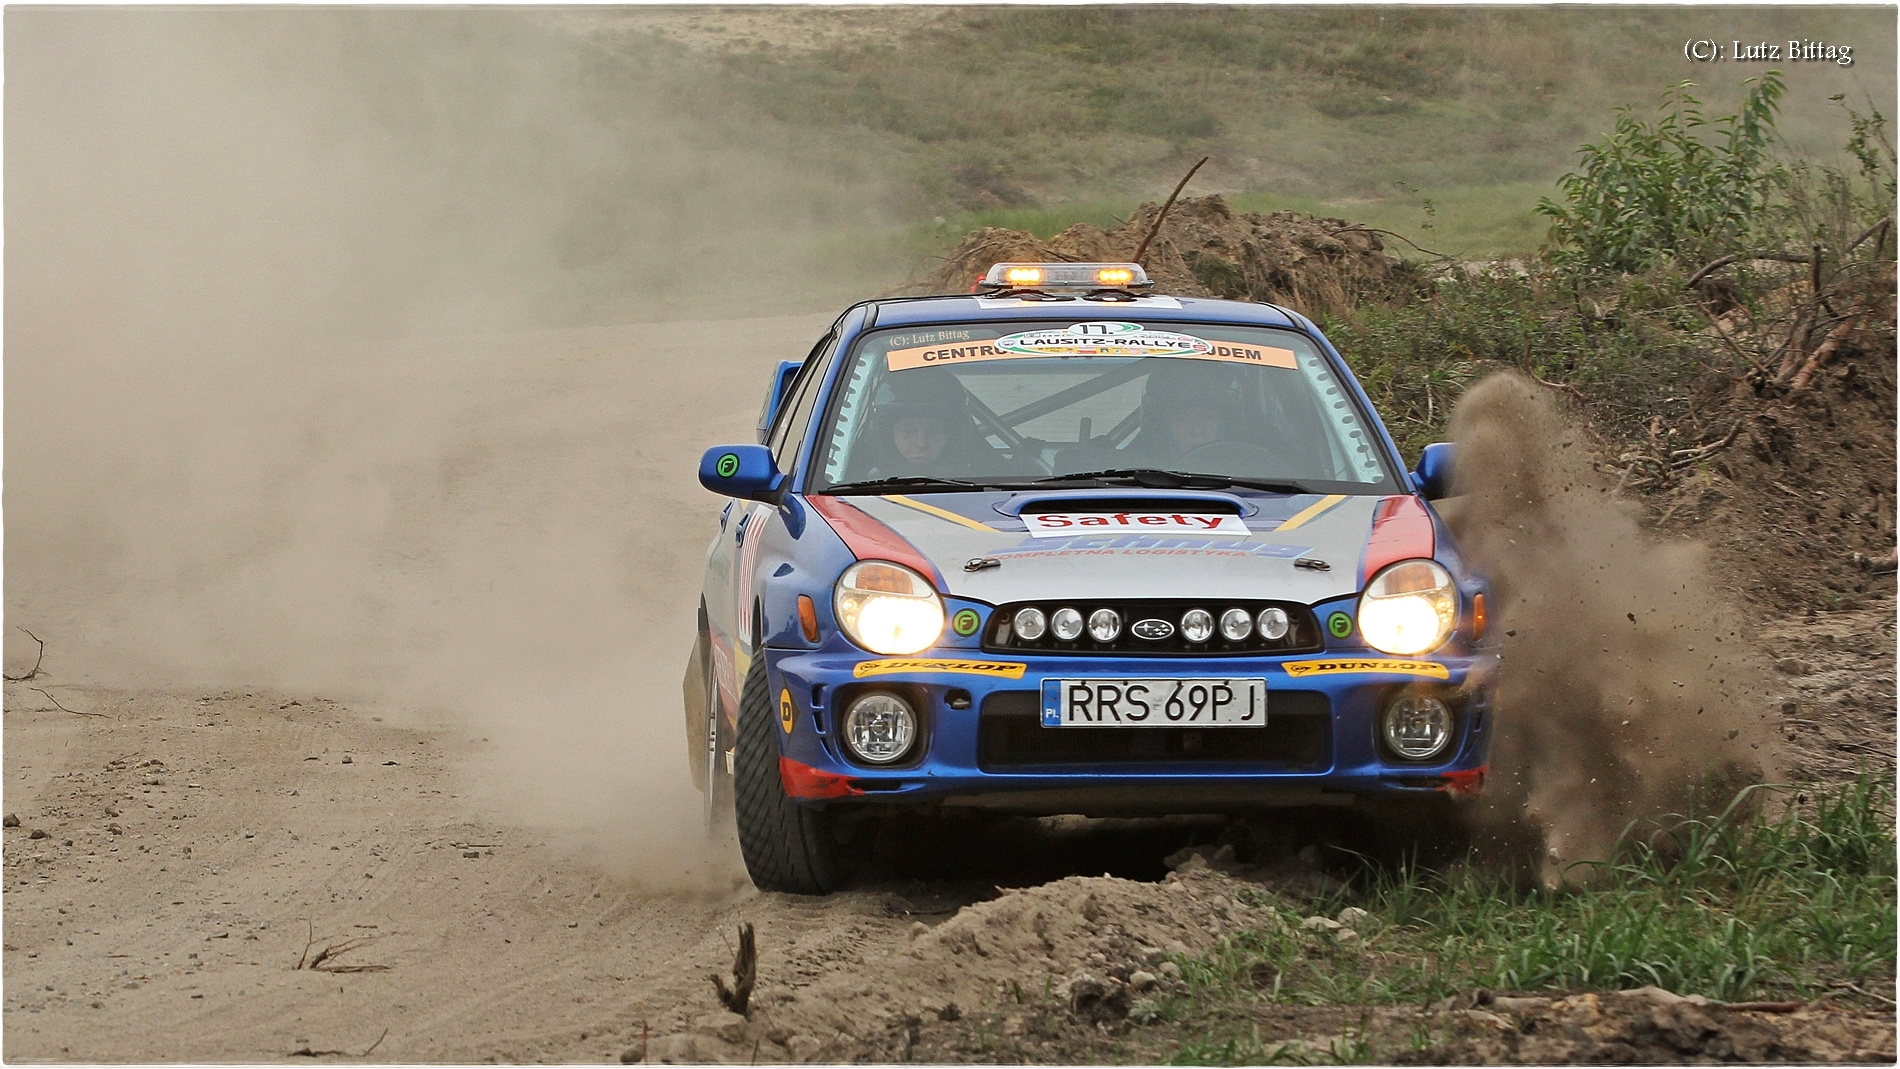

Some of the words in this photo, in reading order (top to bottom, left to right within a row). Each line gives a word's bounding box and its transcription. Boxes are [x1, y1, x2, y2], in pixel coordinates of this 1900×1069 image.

[1019, 338, 1192, 350] LAUSITZ-RALLYE
[1036, 512, 1224, 530] Safety
[1121, 549, 1248, 558] LOGISTYKA
[884, 662, 1018, 671] DUNLOP
[1317, 662, 1440, 671] DUNLOP
[1068, 684, 1150, 722] RRS
[1045, 708, 1059, 719] PL
